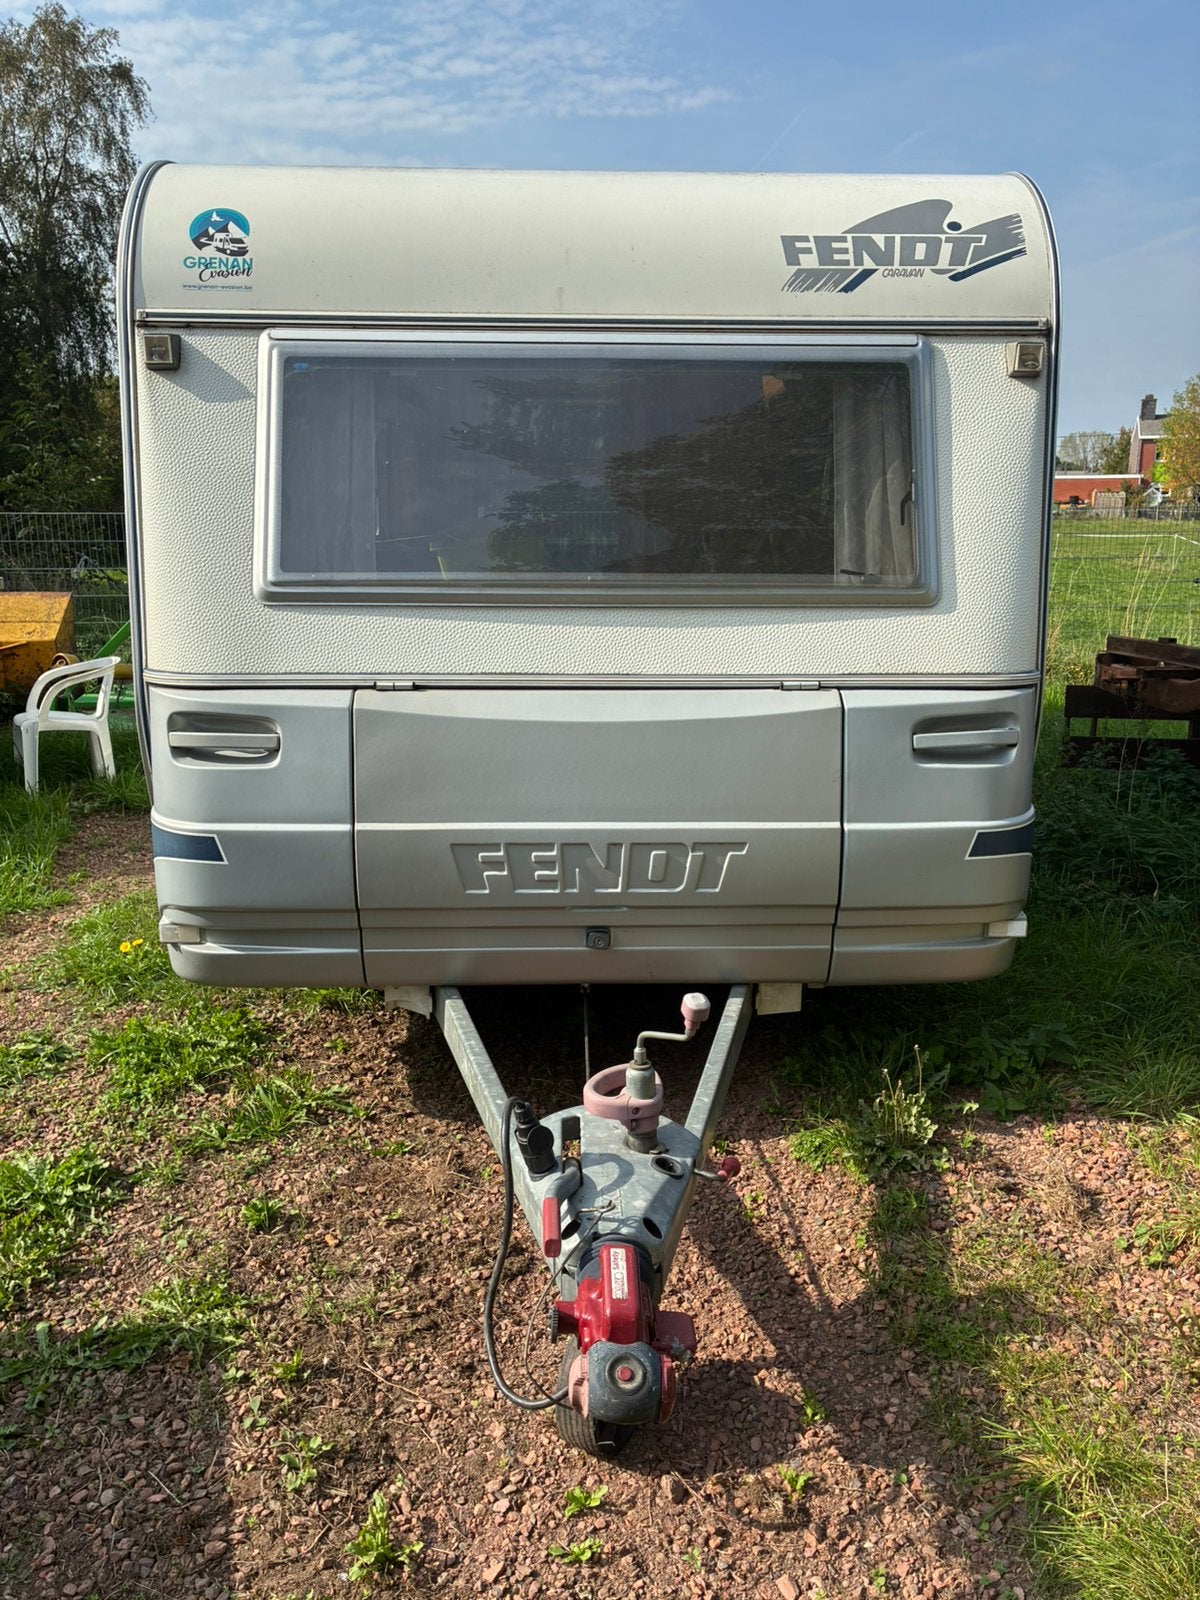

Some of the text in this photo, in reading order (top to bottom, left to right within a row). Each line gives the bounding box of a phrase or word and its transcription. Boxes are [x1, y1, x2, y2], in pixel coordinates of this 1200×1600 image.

[780, 235, 983, 267] FENDT
[183, 256, 253, 270] GRENAN
[199, 262, 252, 282] Evasion
[882, 268, 925, 278] CARAVAN
[450, 843, 749, 893] FENDT
